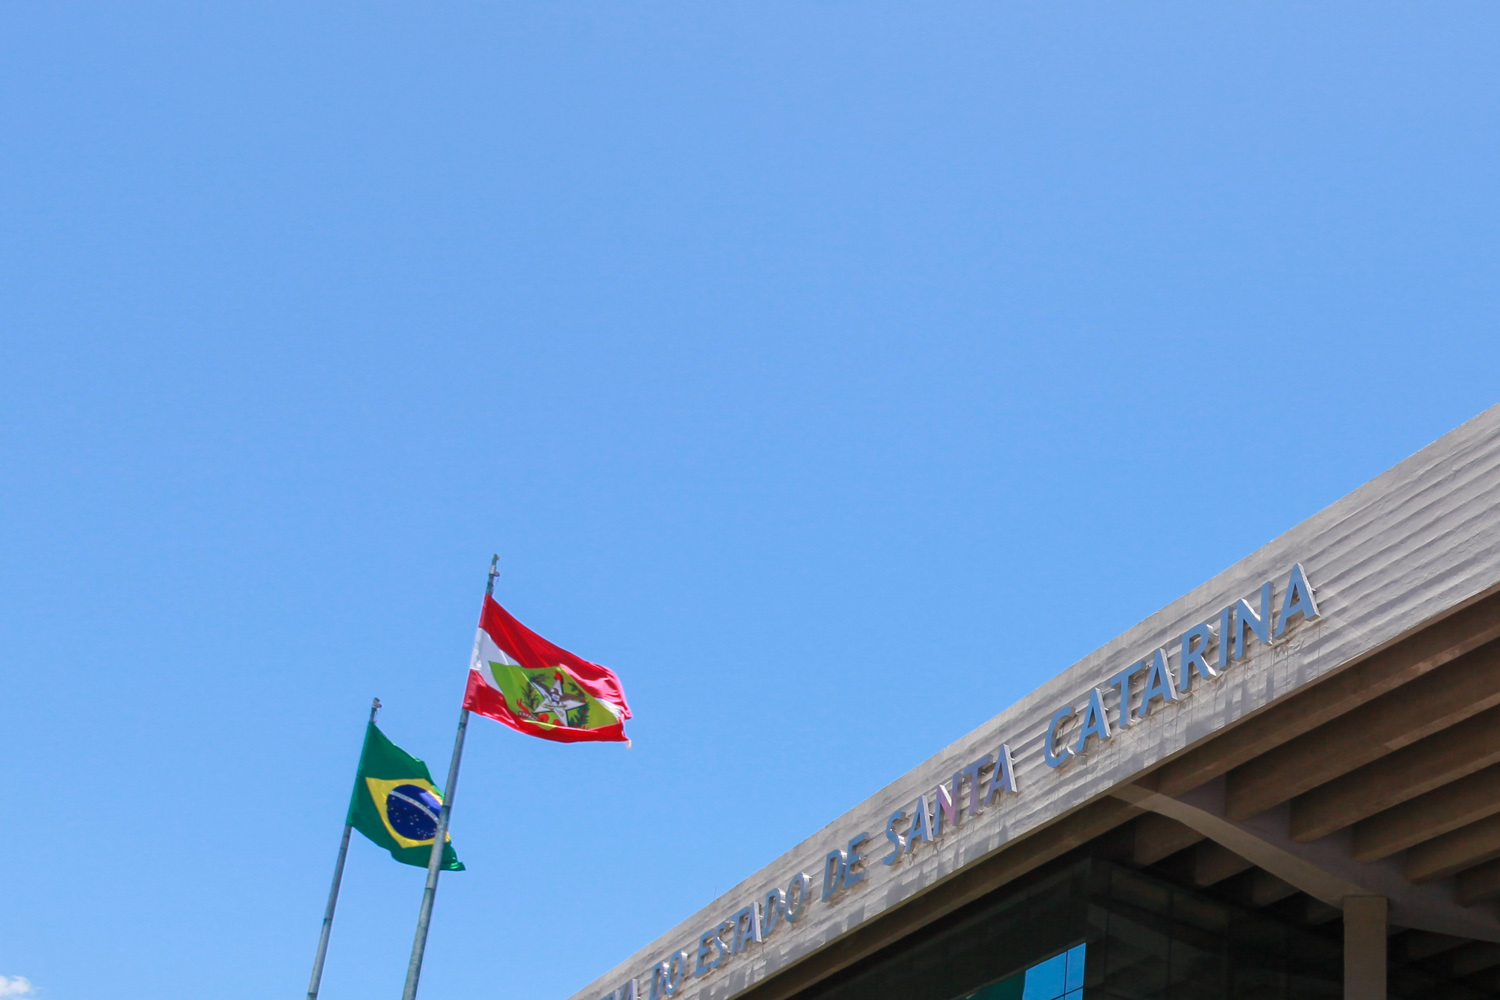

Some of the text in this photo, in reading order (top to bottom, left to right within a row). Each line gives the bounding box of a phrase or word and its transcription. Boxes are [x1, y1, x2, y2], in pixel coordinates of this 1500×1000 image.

[695, 871, 812, 977] ESTADO
[823, 832, 869, 903] DE
[882, 743, 1018, 866] SANTA
[1043, 562, 1320, 769] CATARINA
